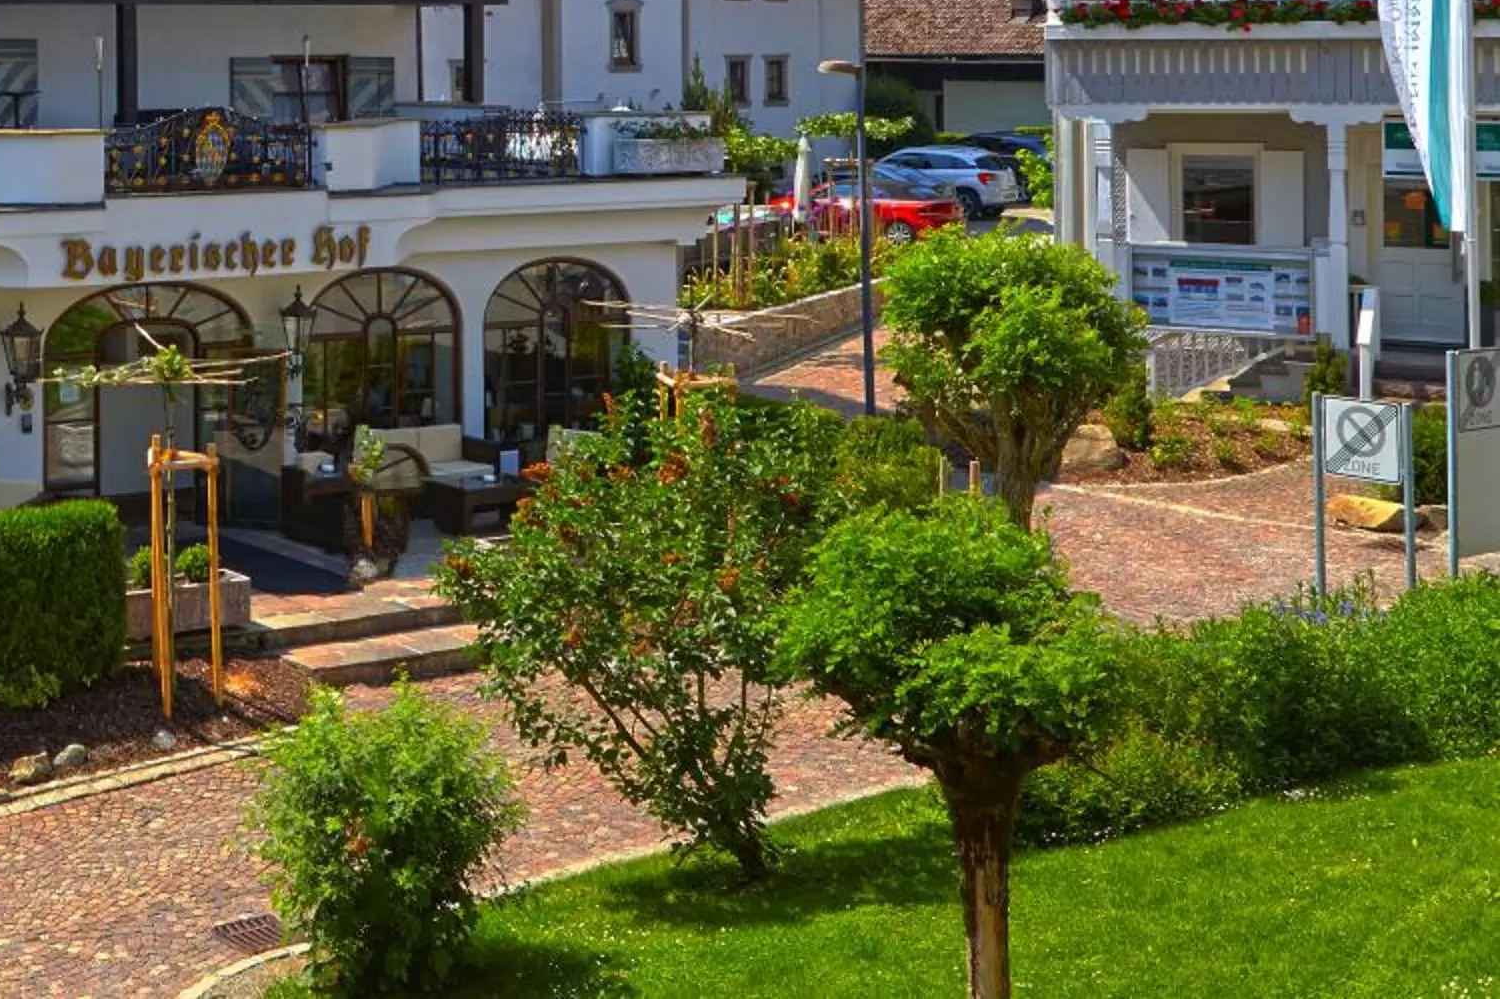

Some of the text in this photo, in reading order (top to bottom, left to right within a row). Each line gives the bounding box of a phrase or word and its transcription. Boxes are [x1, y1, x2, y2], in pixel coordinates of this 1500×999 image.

[61, 223, 370, 282] Bayerischer Hof
[1343, 459, 1381, 476] ZONE
